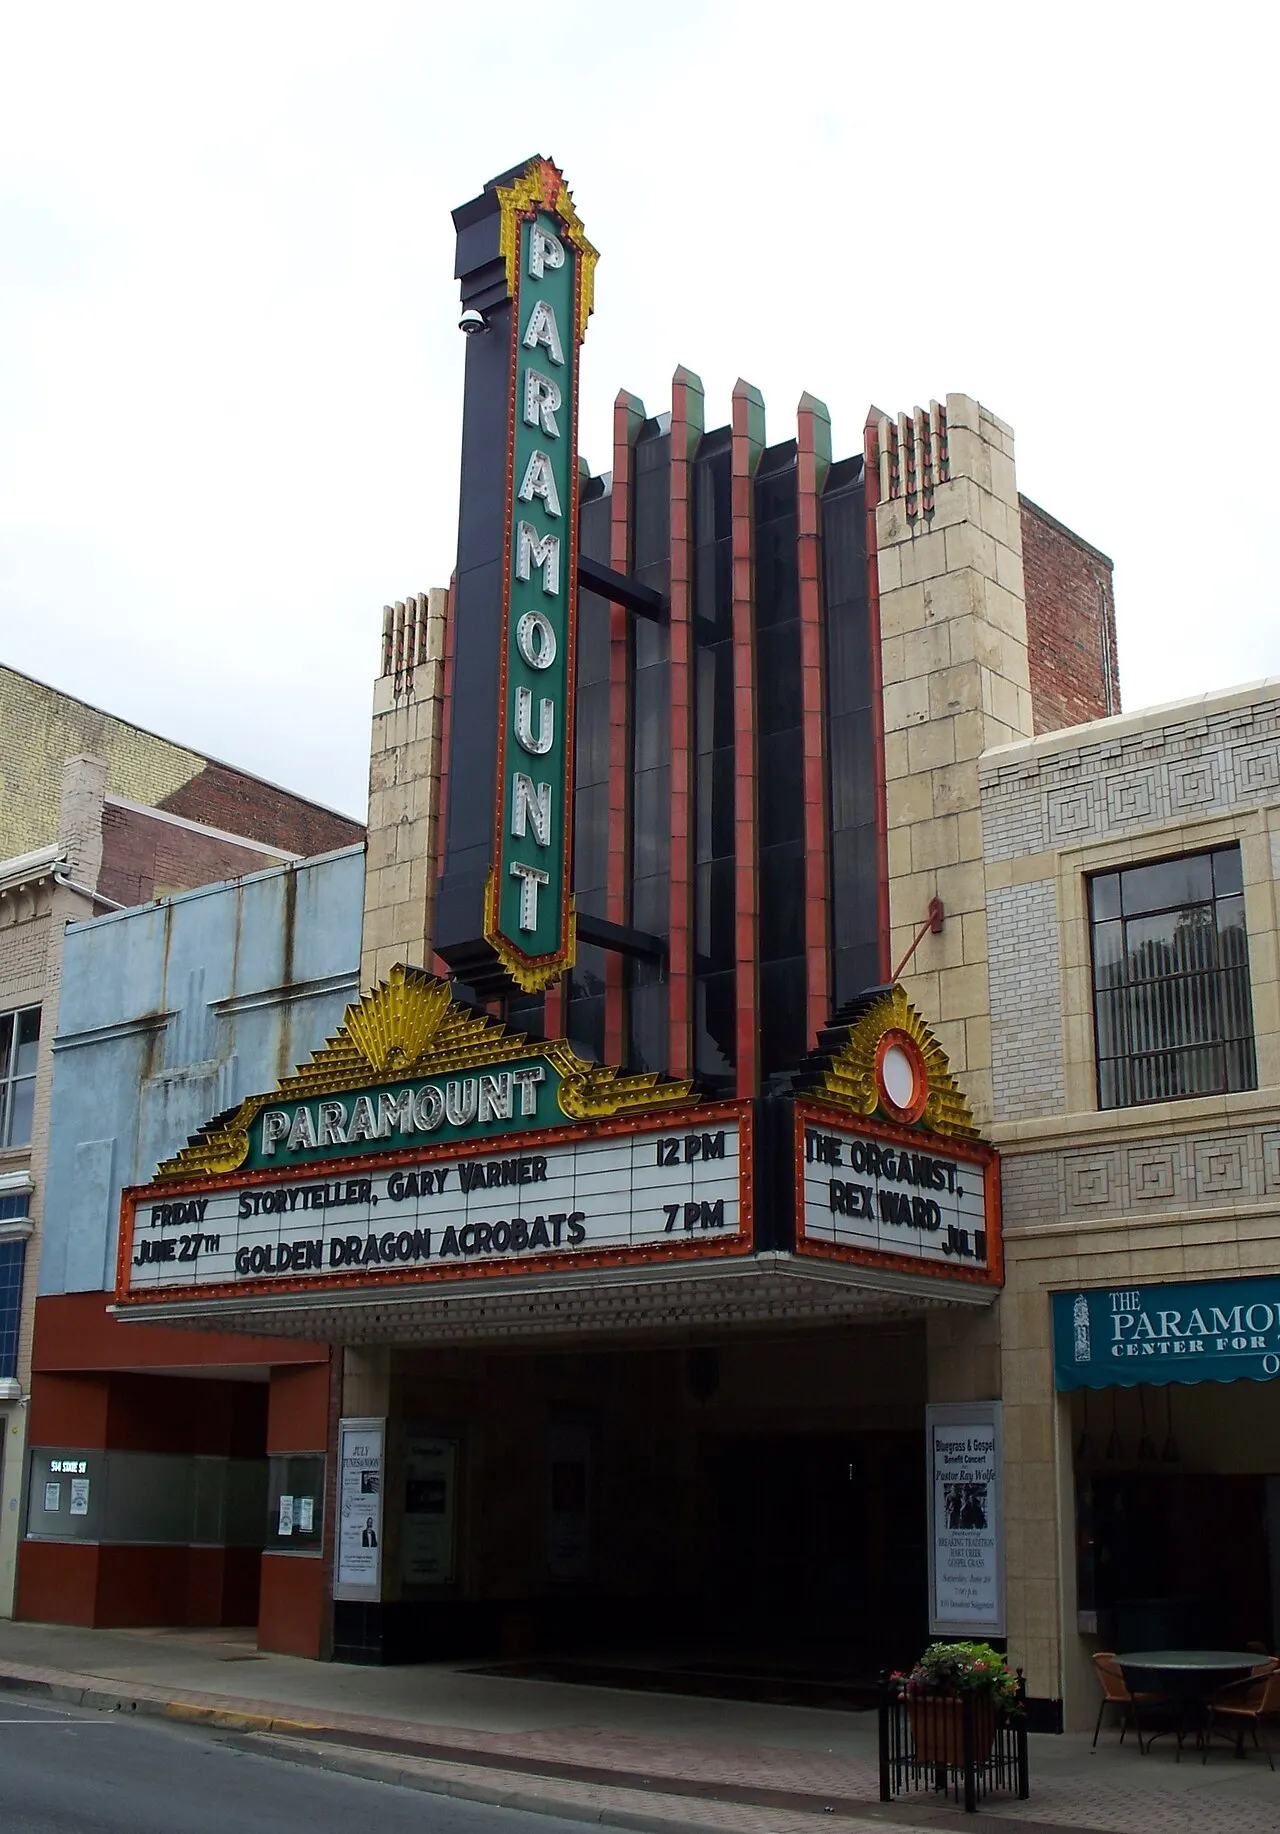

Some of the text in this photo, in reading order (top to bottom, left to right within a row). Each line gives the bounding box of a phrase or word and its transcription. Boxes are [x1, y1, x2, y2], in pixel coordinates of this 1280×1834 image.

[510, 222, 565, 933] PARAMOUNT
[261, 1066, 546, 1155] PARAMOUNT
[804, 1128, 843, 1166] THE
[238, 1130, 725, 1219] STORYTELLER, GARY VARNER 12 PM
[150, 1199, 209, 1229] FRIDAY
[829, 1178, 942, 1231] REX WARD
[133, 1233, 221, 1266] JUNE 27TH
[235, 1199, 725, 1275] GOLDEN DRAGON ACROBATS 7 PM
[942, 1224, 974, 1256] JUL
[1109, 1290, 1142, 1312] THE
[1111, 1336, 1267, 1357] CENTER FOR
[936, 1438, 995, 1454] Bluegrass & Gospel
[944, 1455, 986, 1464] Benefit Concert
[936, 1468, 996, 1483] Pastor Ray Wolfe
